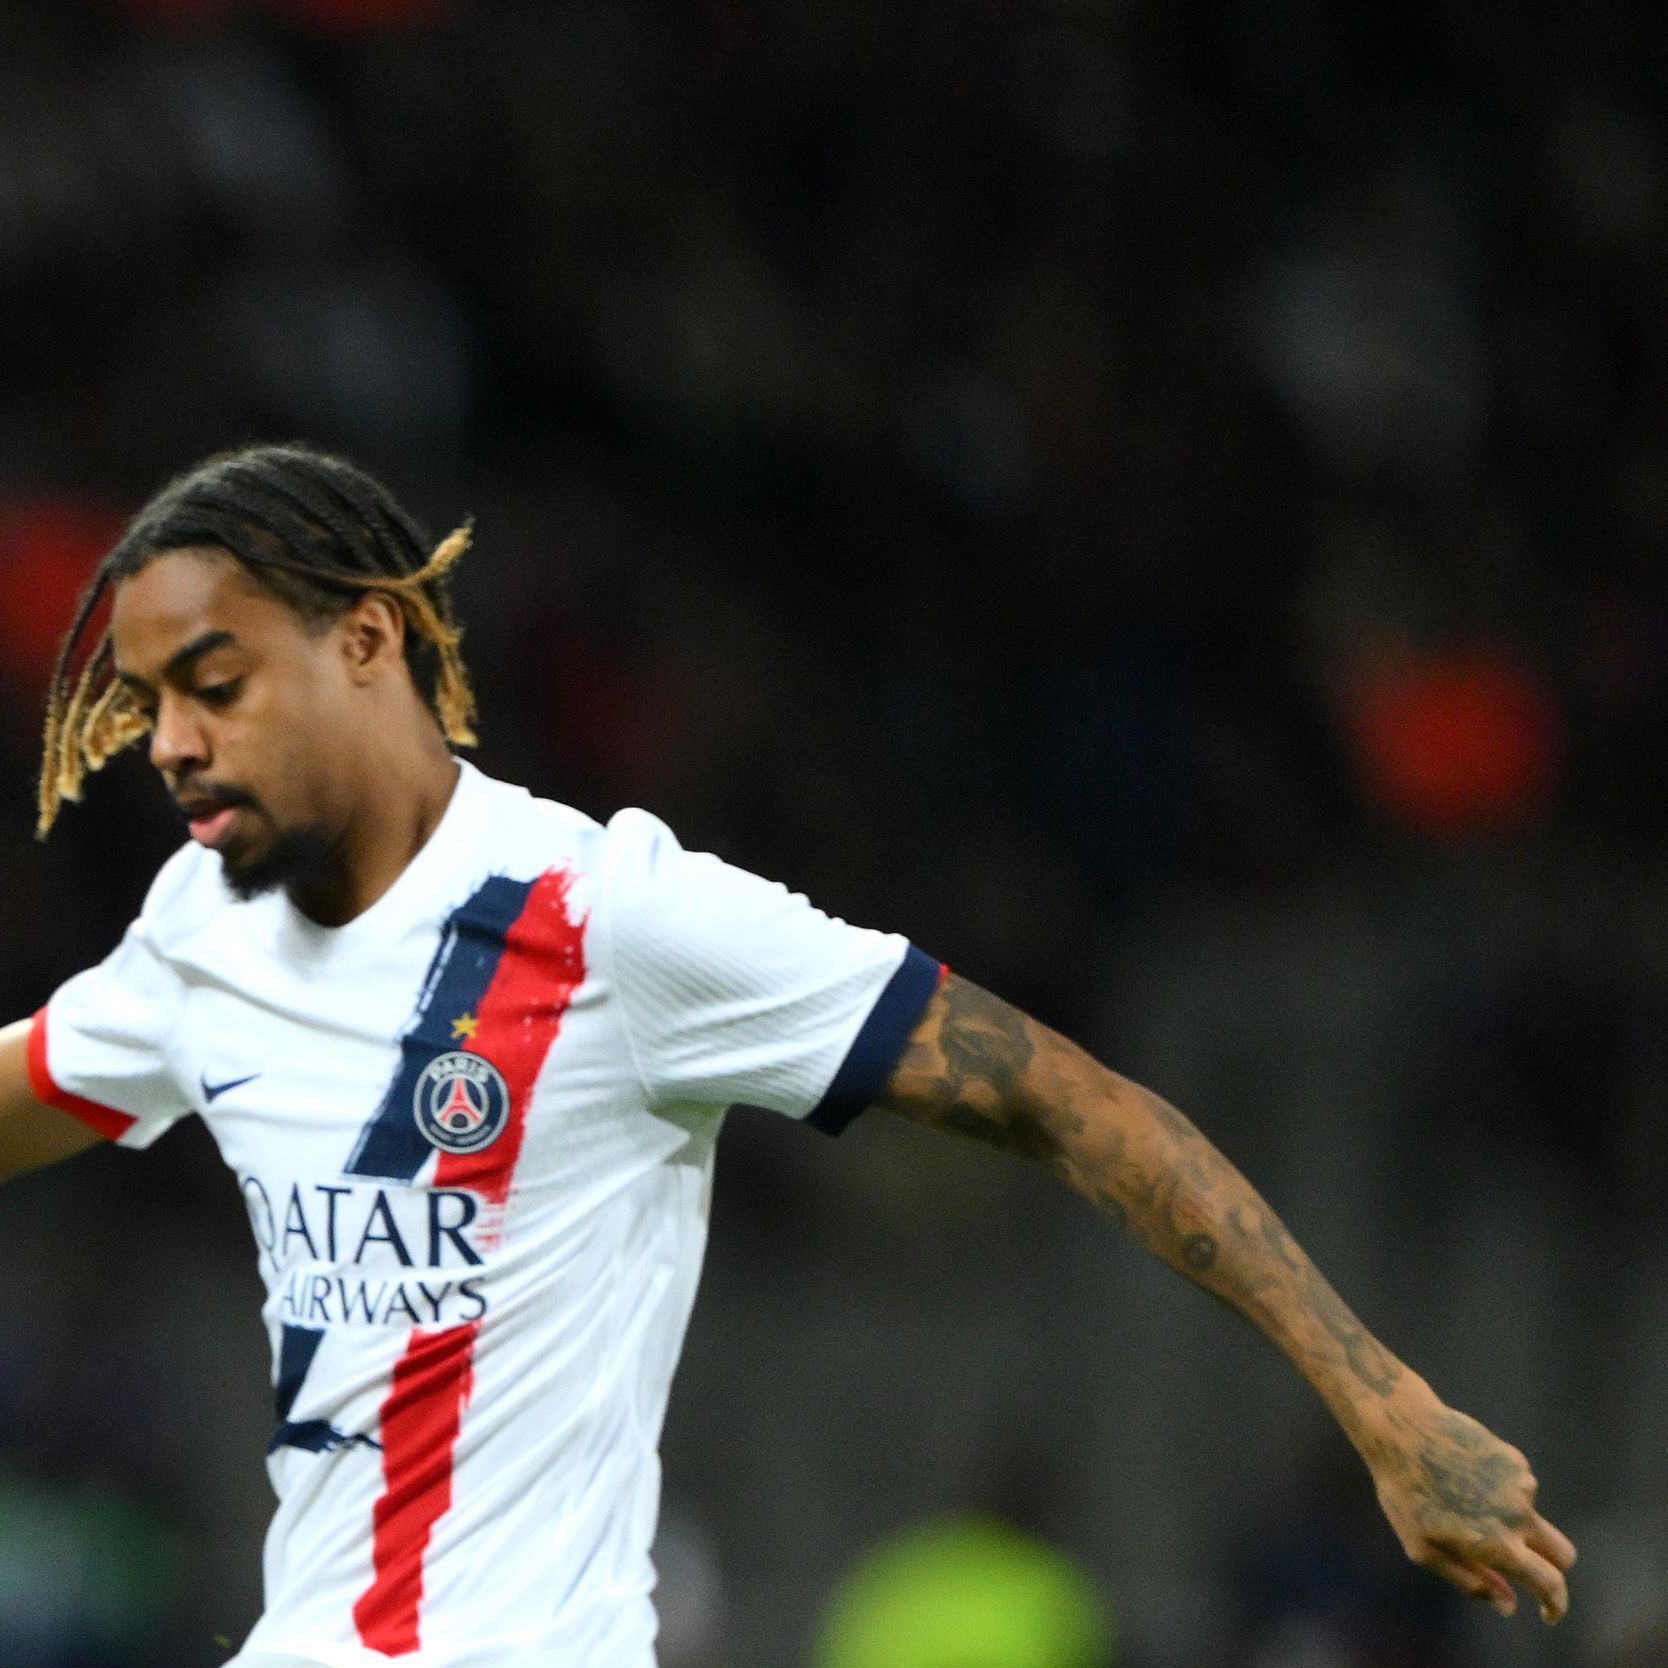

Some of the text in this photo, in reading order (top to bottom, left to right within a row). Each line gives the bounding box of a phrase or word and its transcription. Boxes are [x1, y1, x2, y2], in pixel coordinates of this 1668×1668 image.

[426, 1056, 490, 1083] PARIS
[243, 1176, 485, 1273] QATAR
[279, 1271, 489, 1325] AIRWAYS
